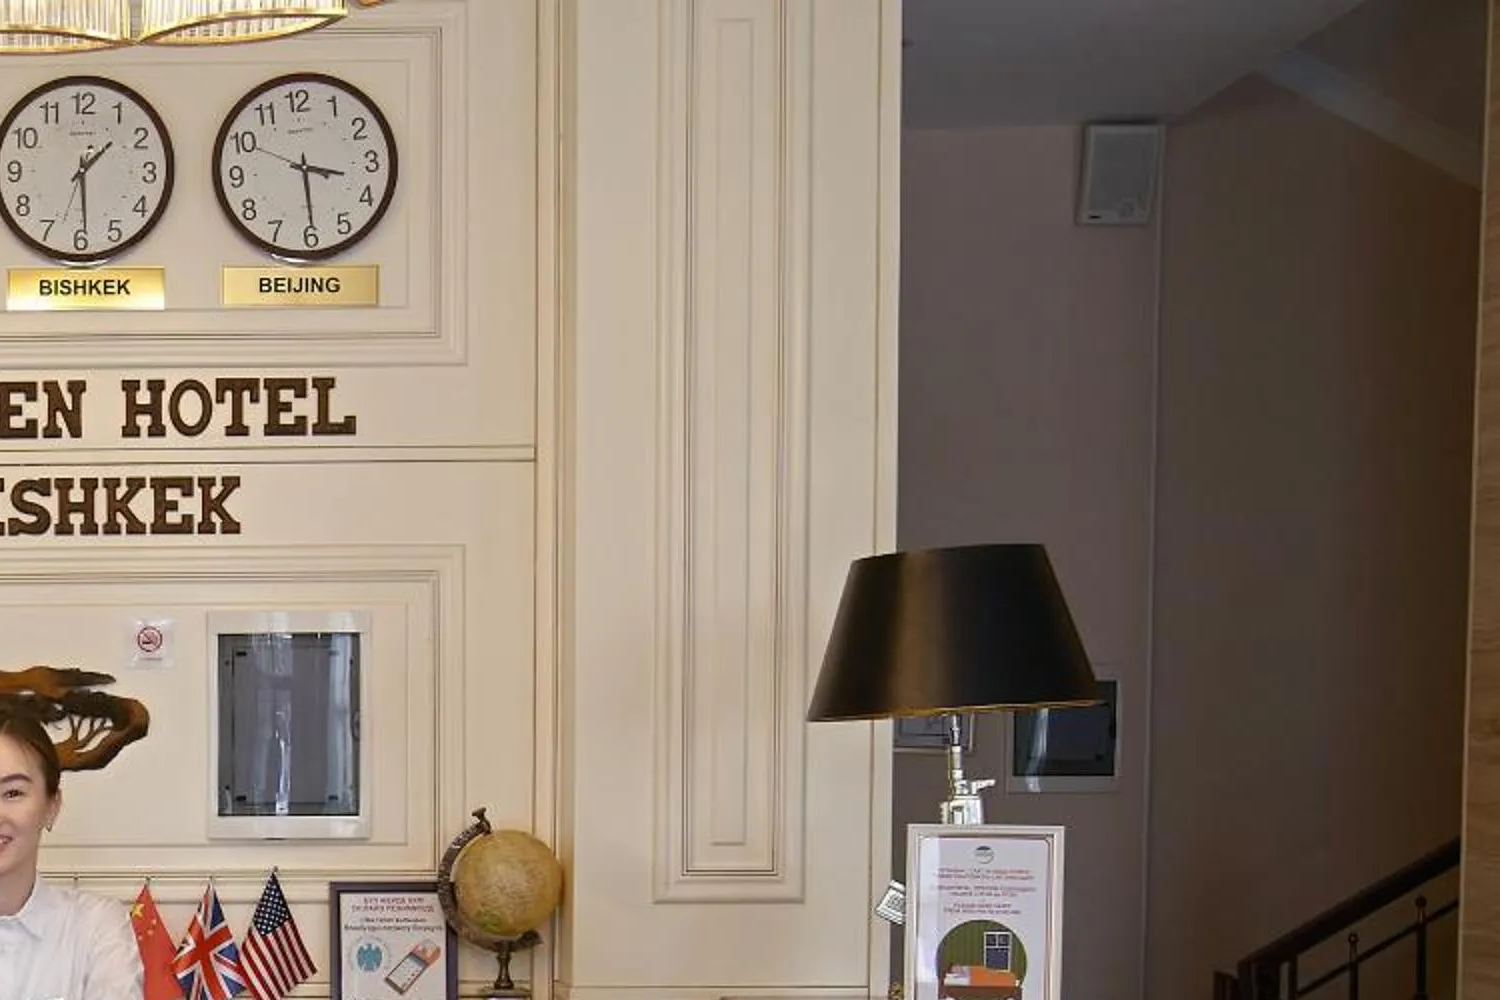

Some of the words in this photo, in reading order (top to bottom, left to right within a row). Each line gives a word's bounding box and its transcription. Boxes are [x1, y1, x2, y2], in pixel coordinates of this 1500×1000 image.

[71, 91, 96, 115] 12
[284, 89, 310, 113] 12
[327, 95, 338, 118] 1
[39, 101, 60, 125] 11
[112, 101, 123, 125] 1
[254, 101, 276, 126] 11
[11, 127, 39, 149] 10
[133, 127, 149, 149] 2
[351, 117, 368, 141] 2
[229, 130, 257, 154] 10
[7, 159, 23, 183] 9
[141, 161, 157, 184] 3
[363, 149, 380, 173] 3
[229, 165, 245, 188] 9
[15, 193, 31, 217] 8
[132, 194, 148, 218] 4
[358, 184, 374, 207] 4
[241, 198, 257, 221] 8
[39, 219, 55, 241] 7
[107, 219, 123, 242] 5
[267, 219, 283, 242] 7
[336, 211, 352, 235] 5
[73, 229, 89, 251] 6
[303, 225, 319, 248] 6
[38, 278, 131, 296] BISHKEK
[258, 277, 341, 295] BEIJING
[121, 377, 357, 438] HOTEL
